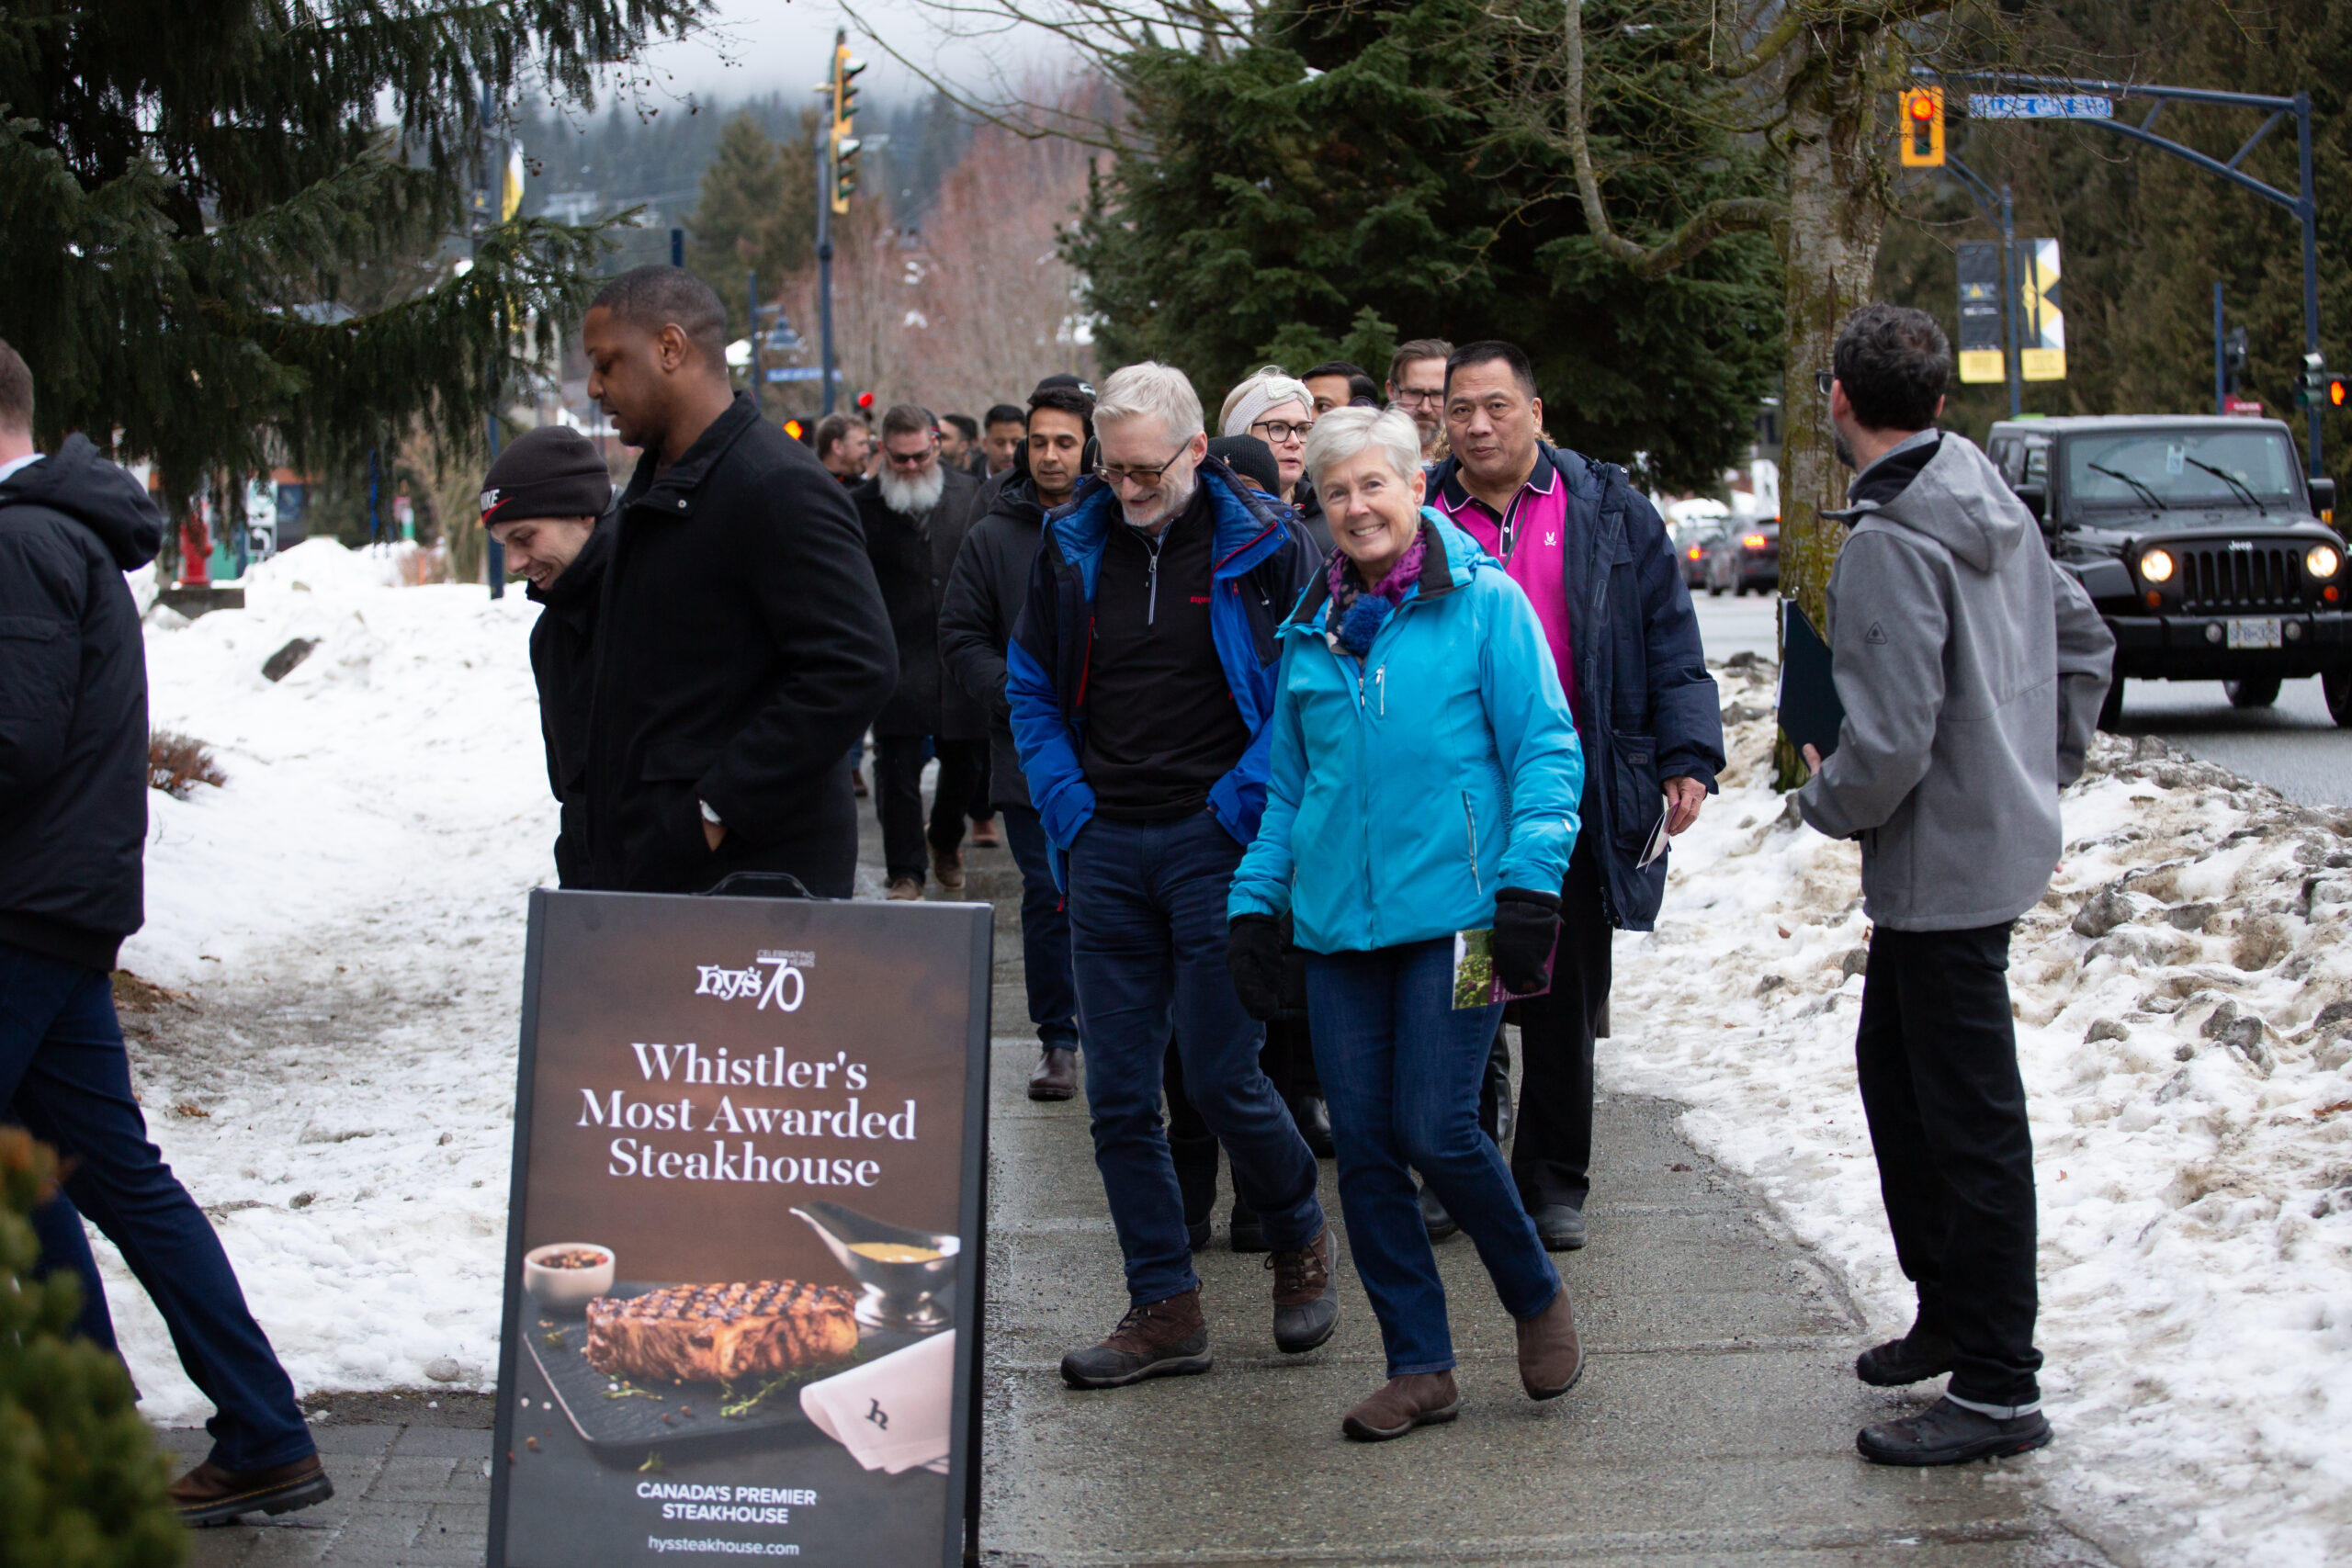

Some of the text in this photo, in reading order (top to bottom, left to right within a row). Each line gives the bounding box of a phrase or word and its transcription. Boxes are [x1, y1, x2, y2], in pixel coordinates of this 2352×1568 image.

[2228, 540, 2253, 551] Jeep
[757, 949, 815, 961] CELEBRATING
[789, 959, 815, 968] YEARS
[756, 957, 805, 1012] 70
[631, 1043, 868, 1091] Whistler's
[576, 1089, 918, 1141] Most Awarded
[607, 1137, 881, 1188] Steakhouse
[637, 1482, 818, 1506] CANADA'S PREMIER
[662, 1503, 789, 1525] STEAKHOUSE
[648, 1535, 800, 1556] hyssteakhouse.com
